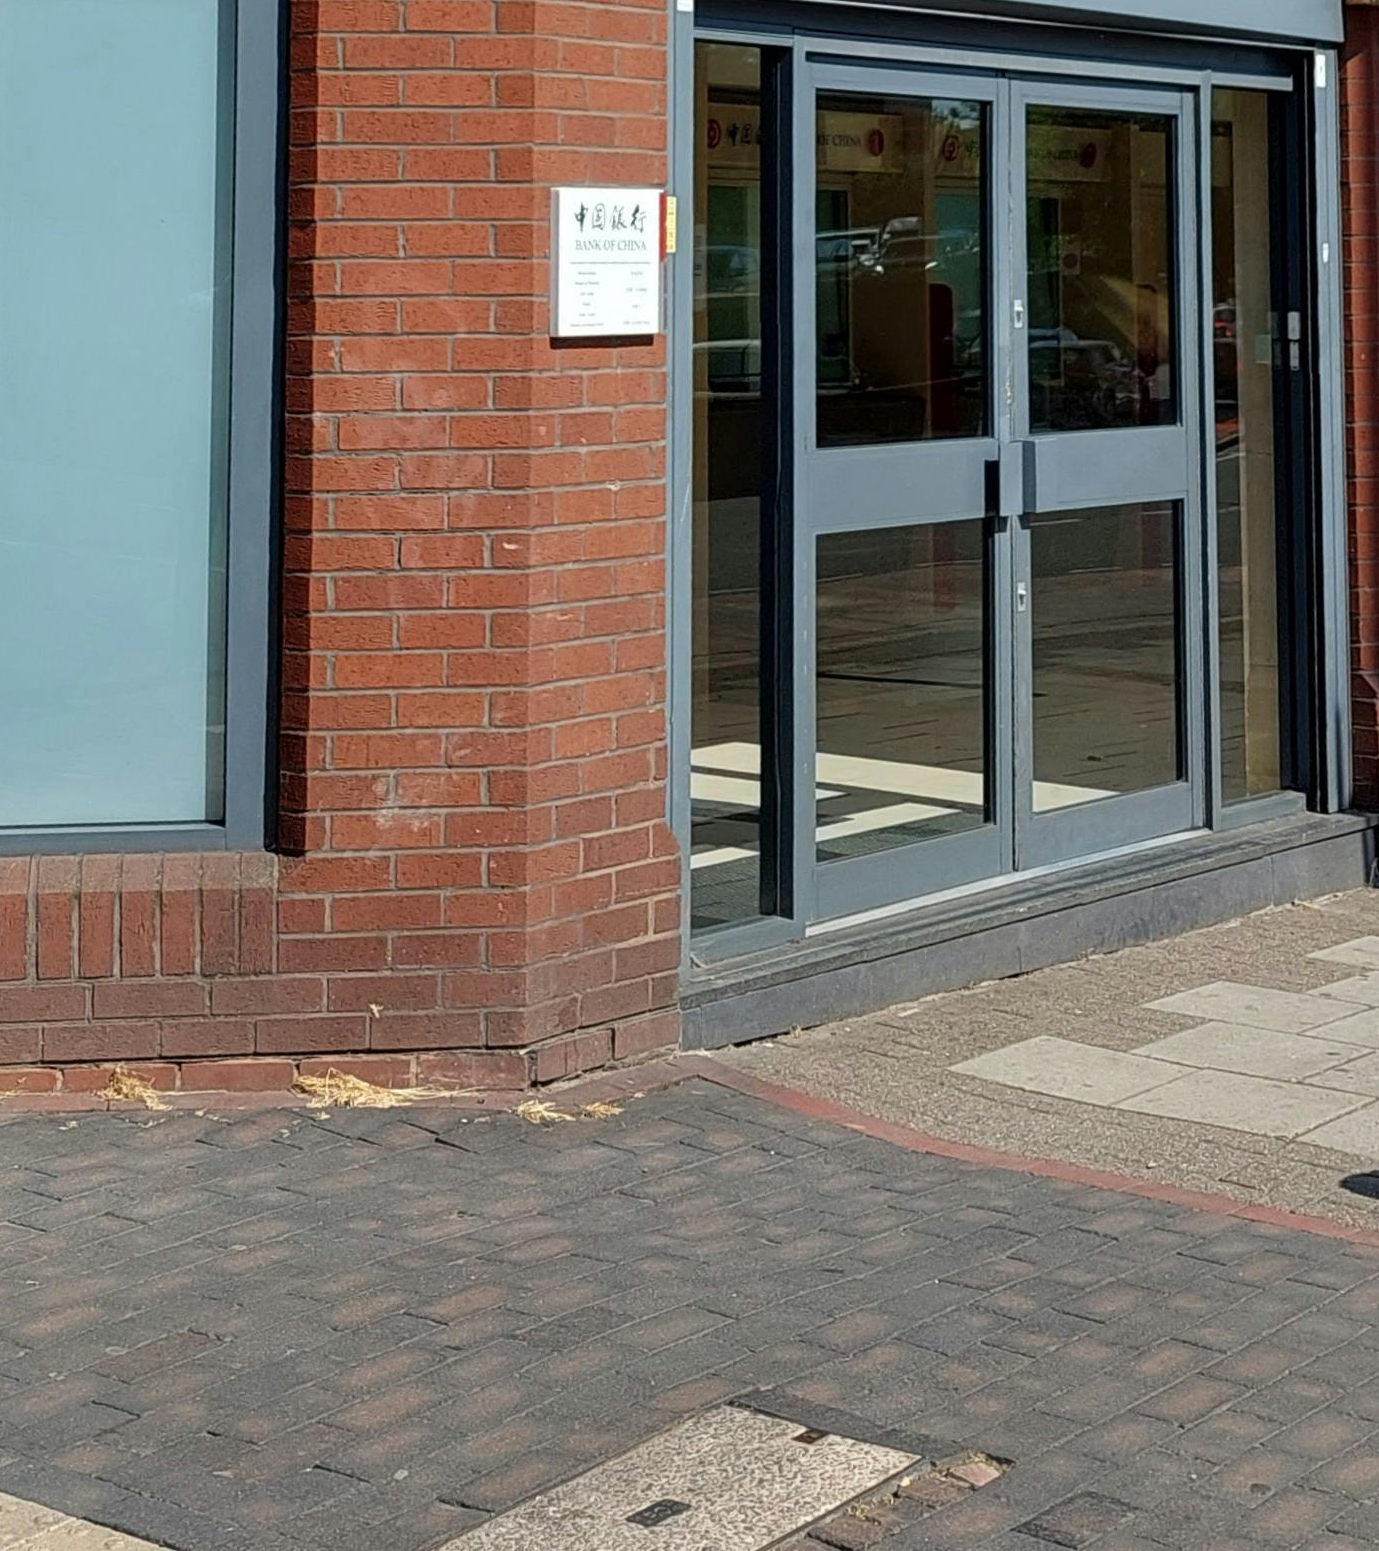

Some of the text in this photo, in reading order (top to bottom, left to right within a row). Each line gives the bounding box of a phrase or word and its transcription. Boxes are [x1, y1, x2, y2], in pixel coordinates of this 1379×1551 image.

[575, 239, 647, 251] BANK OF CHINA
